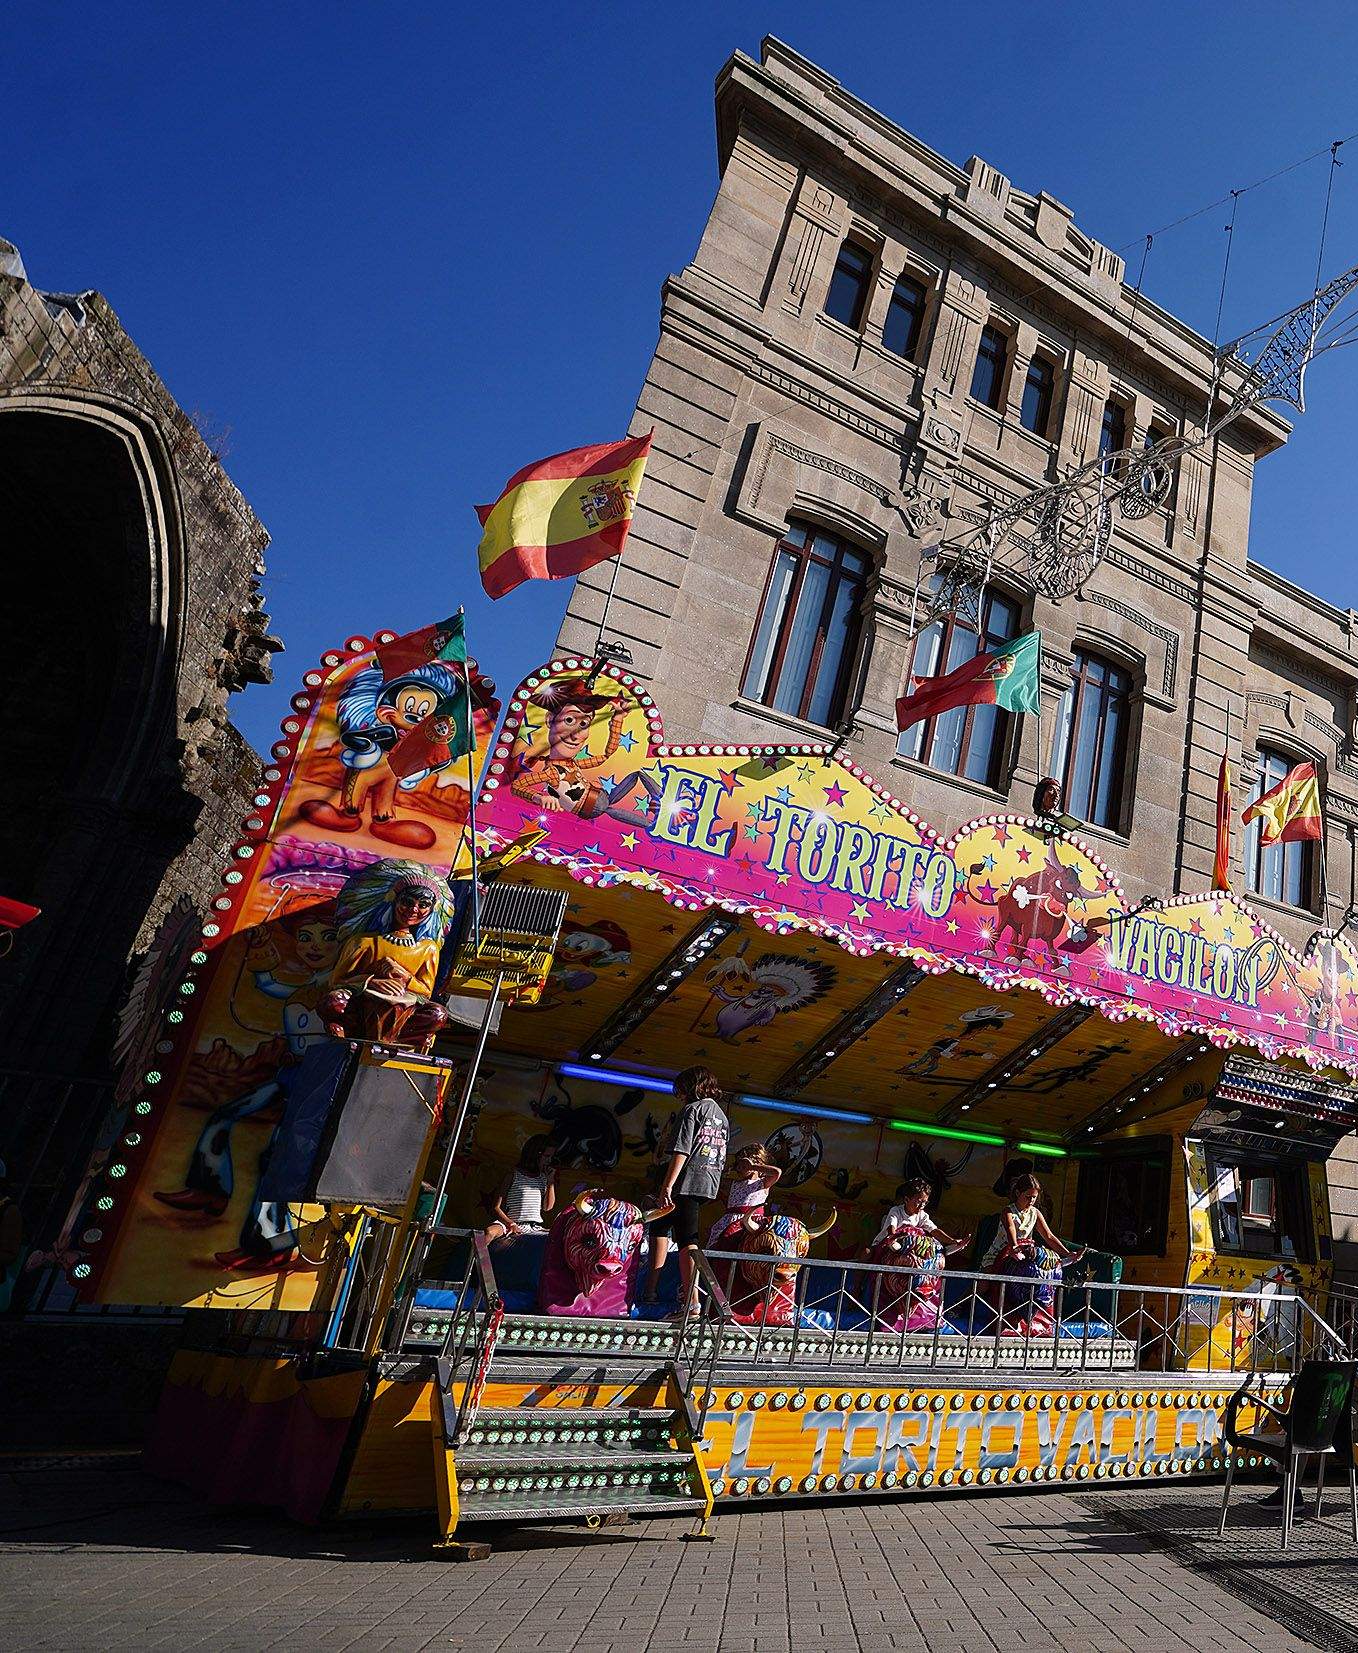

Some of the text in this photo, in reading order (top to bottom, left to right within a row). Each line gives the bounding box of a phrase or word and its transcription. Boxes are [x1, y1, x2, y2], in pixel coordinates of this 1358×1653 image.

[648, 763, 958, 919] EL TORITO
[1107, 907, 1263, 1009] VACILON
[801, 1410, 1025, 1475] TORITO
